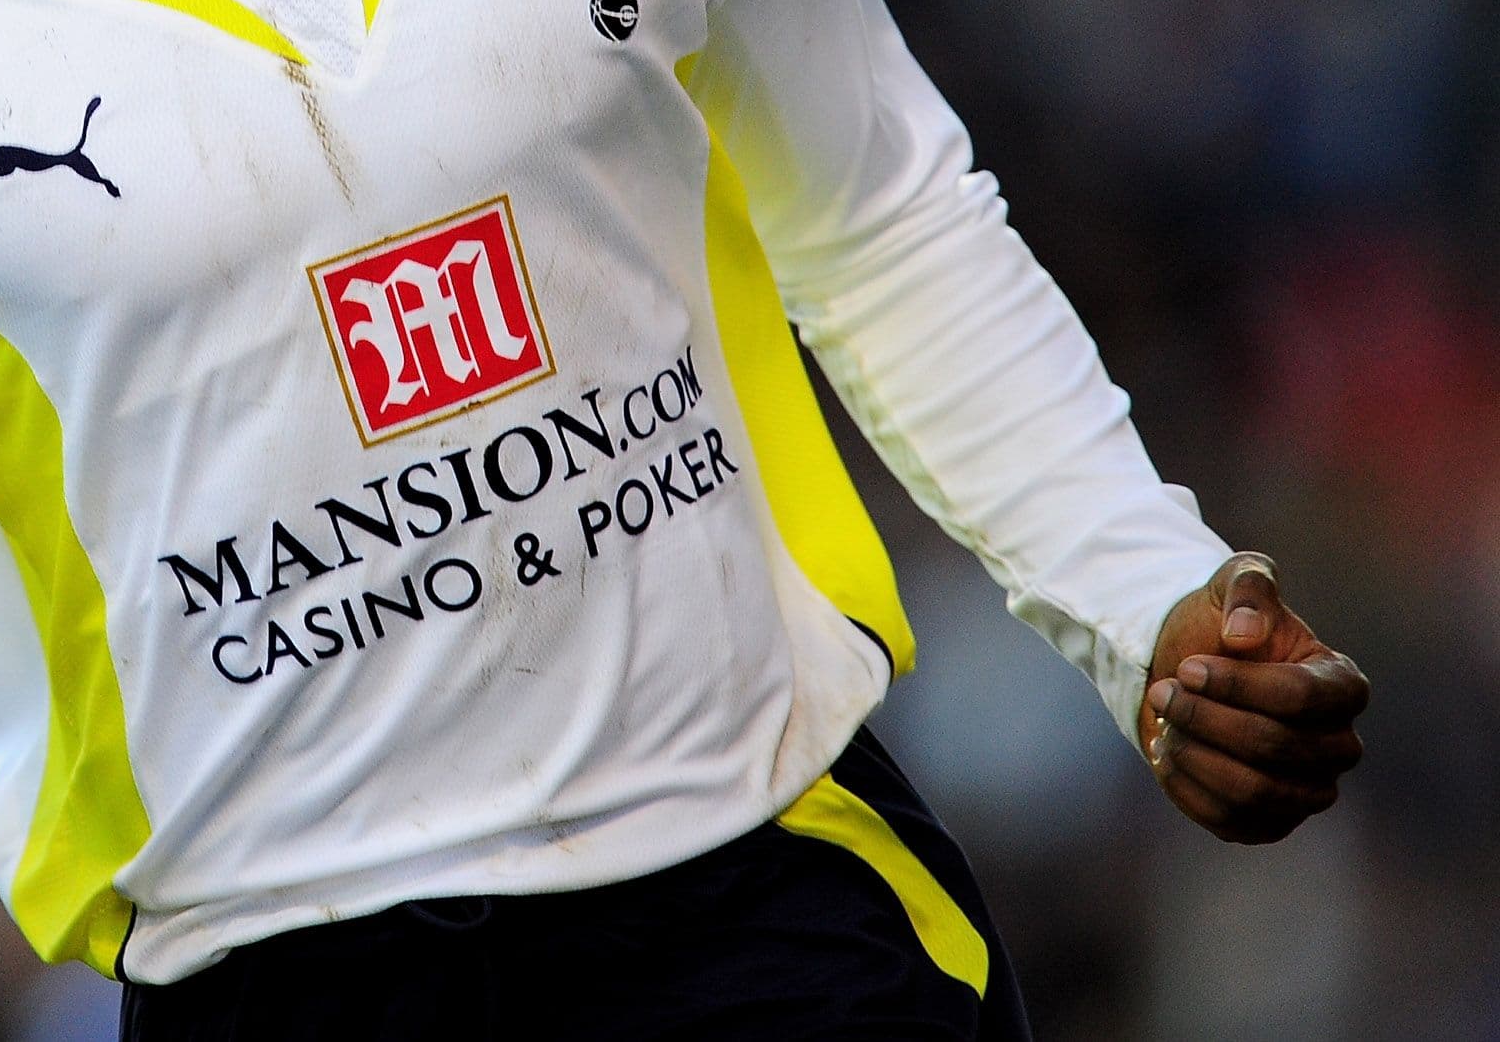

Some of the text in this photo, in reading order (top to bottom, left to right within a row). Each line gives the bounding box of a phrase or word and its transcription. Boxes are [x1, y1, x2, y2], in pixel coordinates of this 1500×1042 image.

[157, 346, 703, 617] MANSION.COM
[212, 428, 739, 685] CASINO & POKER
